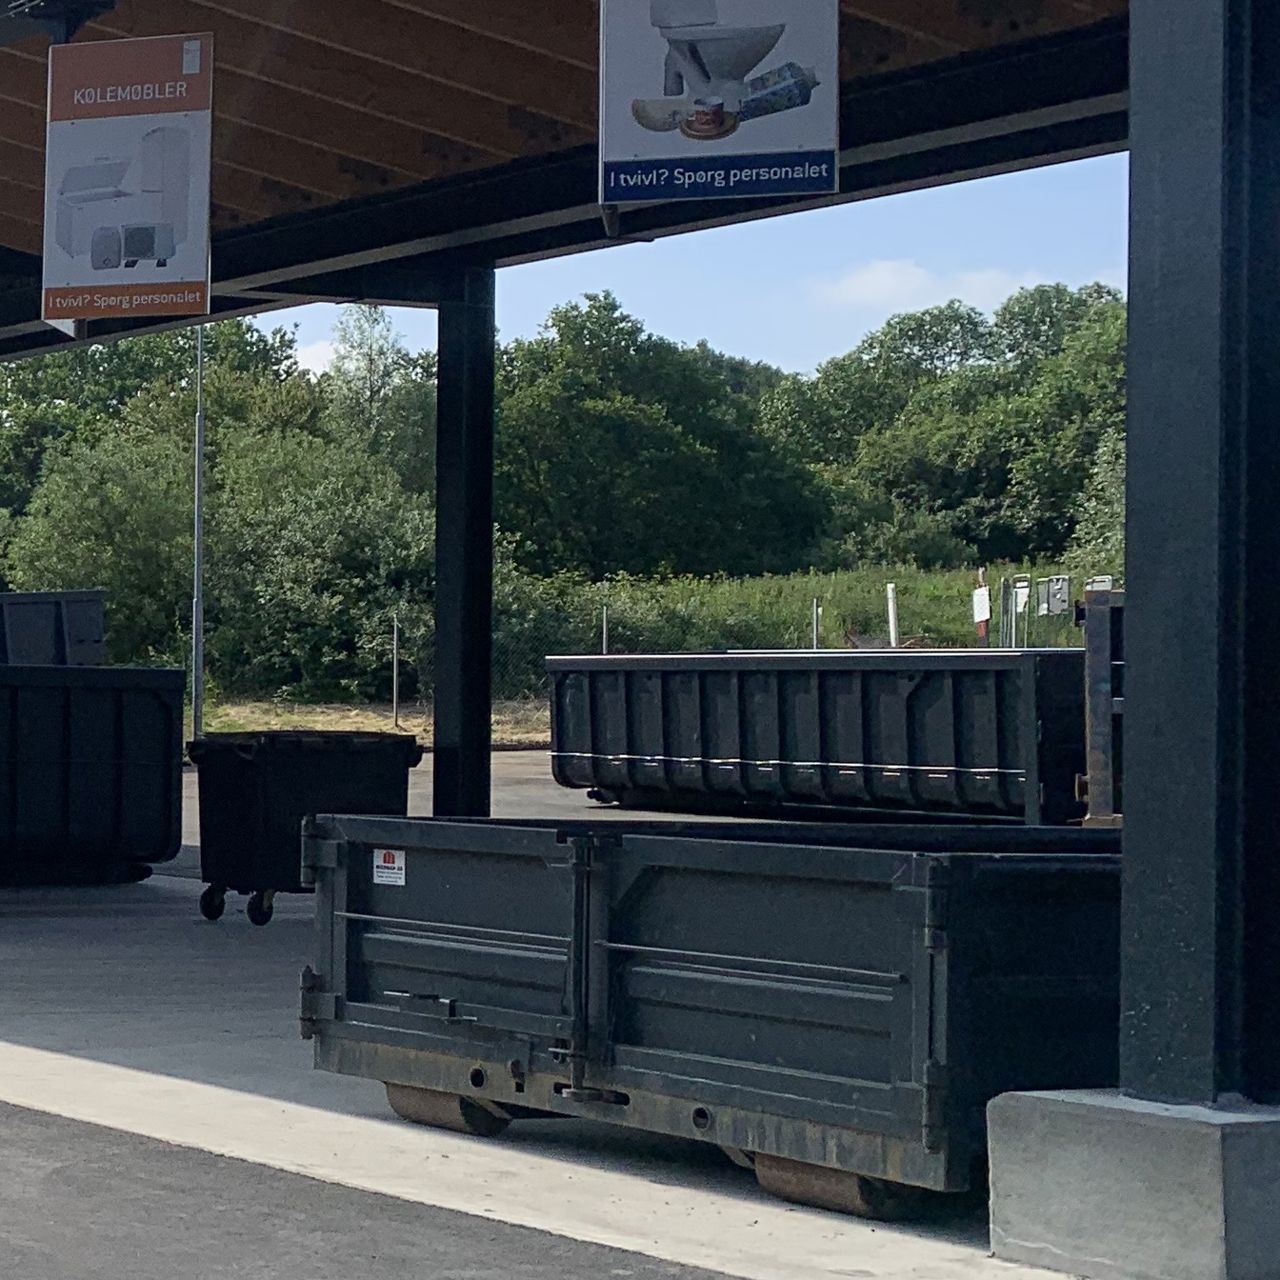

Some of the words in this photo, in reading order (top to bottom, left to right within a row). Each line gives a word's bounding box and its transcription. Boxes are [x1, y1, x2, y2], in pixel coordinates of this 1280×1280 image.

[74, 81, 187, 105] KØLEMØBLER
[610, 172, 615, 187] I
[619, 169, 670, 187] tvivl?
[673, 167, 726, 189] Spørg
[729, 161, 828, 187] personalet
[56, 294, 91, 309] tvivl?
[93, 293, 130, 310] Spørg
[132, 289, 201, 308] personalet
